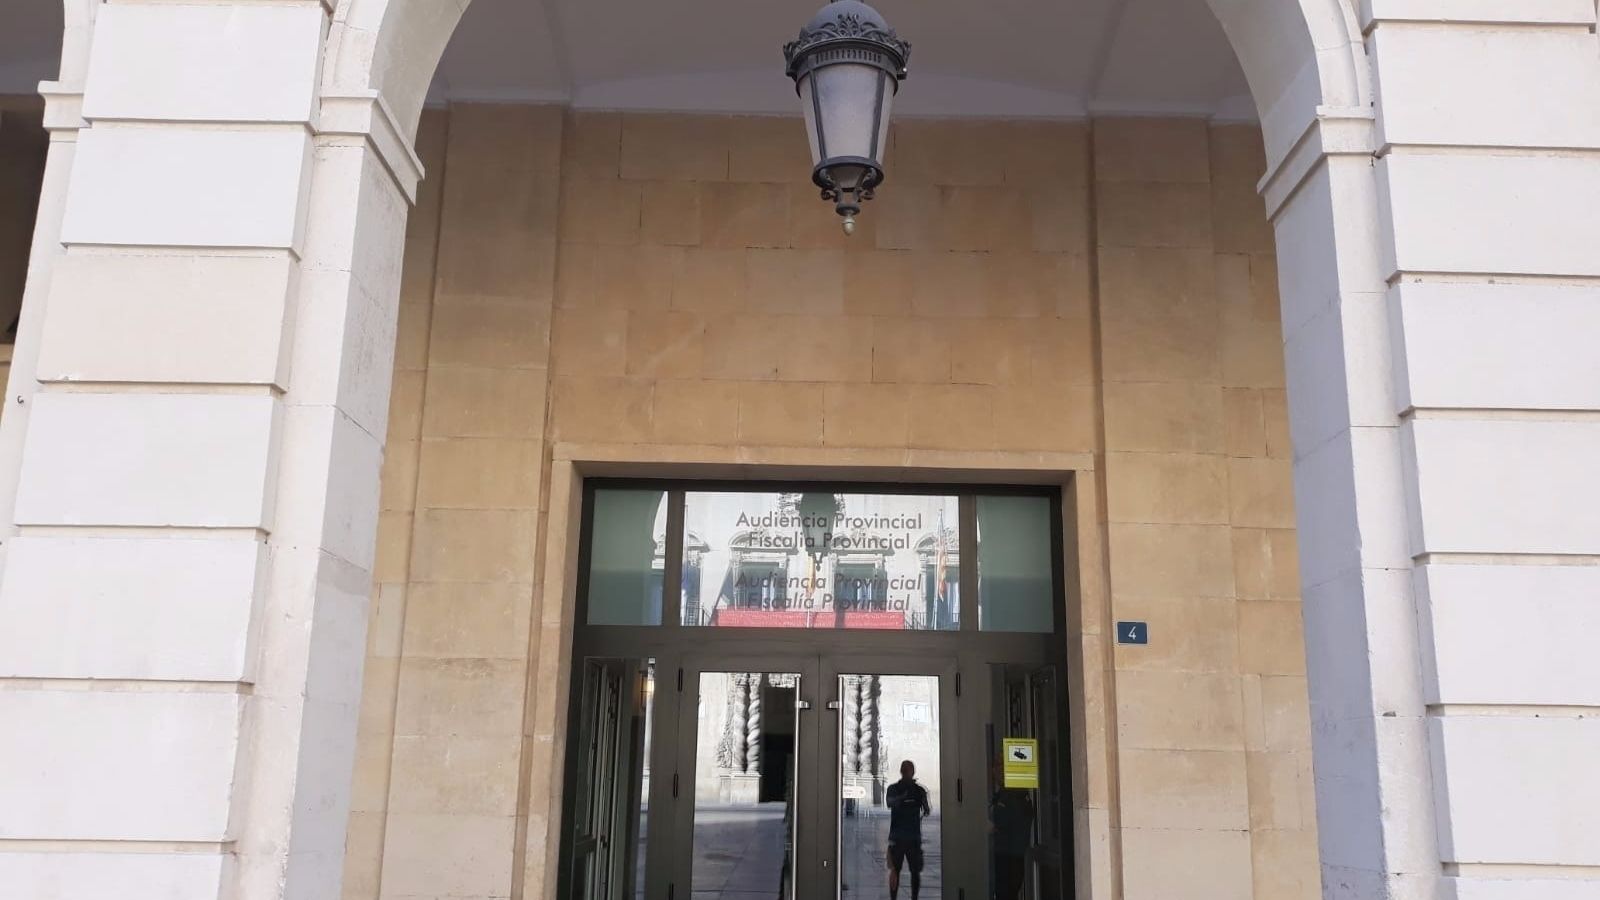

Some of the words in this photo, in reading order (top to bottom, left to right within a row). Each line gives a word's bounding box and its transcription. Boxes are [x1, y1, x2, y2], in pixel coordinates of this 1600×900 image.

[835, 513, 921, 529] Provincial
[824, 532, 909, 549] Provincial
[734, 571, 826, 589] Audiencia
[834, 573, 921, 590] Provincial
[822, 593, 910, 611] Provincial
[1128, 626, 1136, 640] 4
